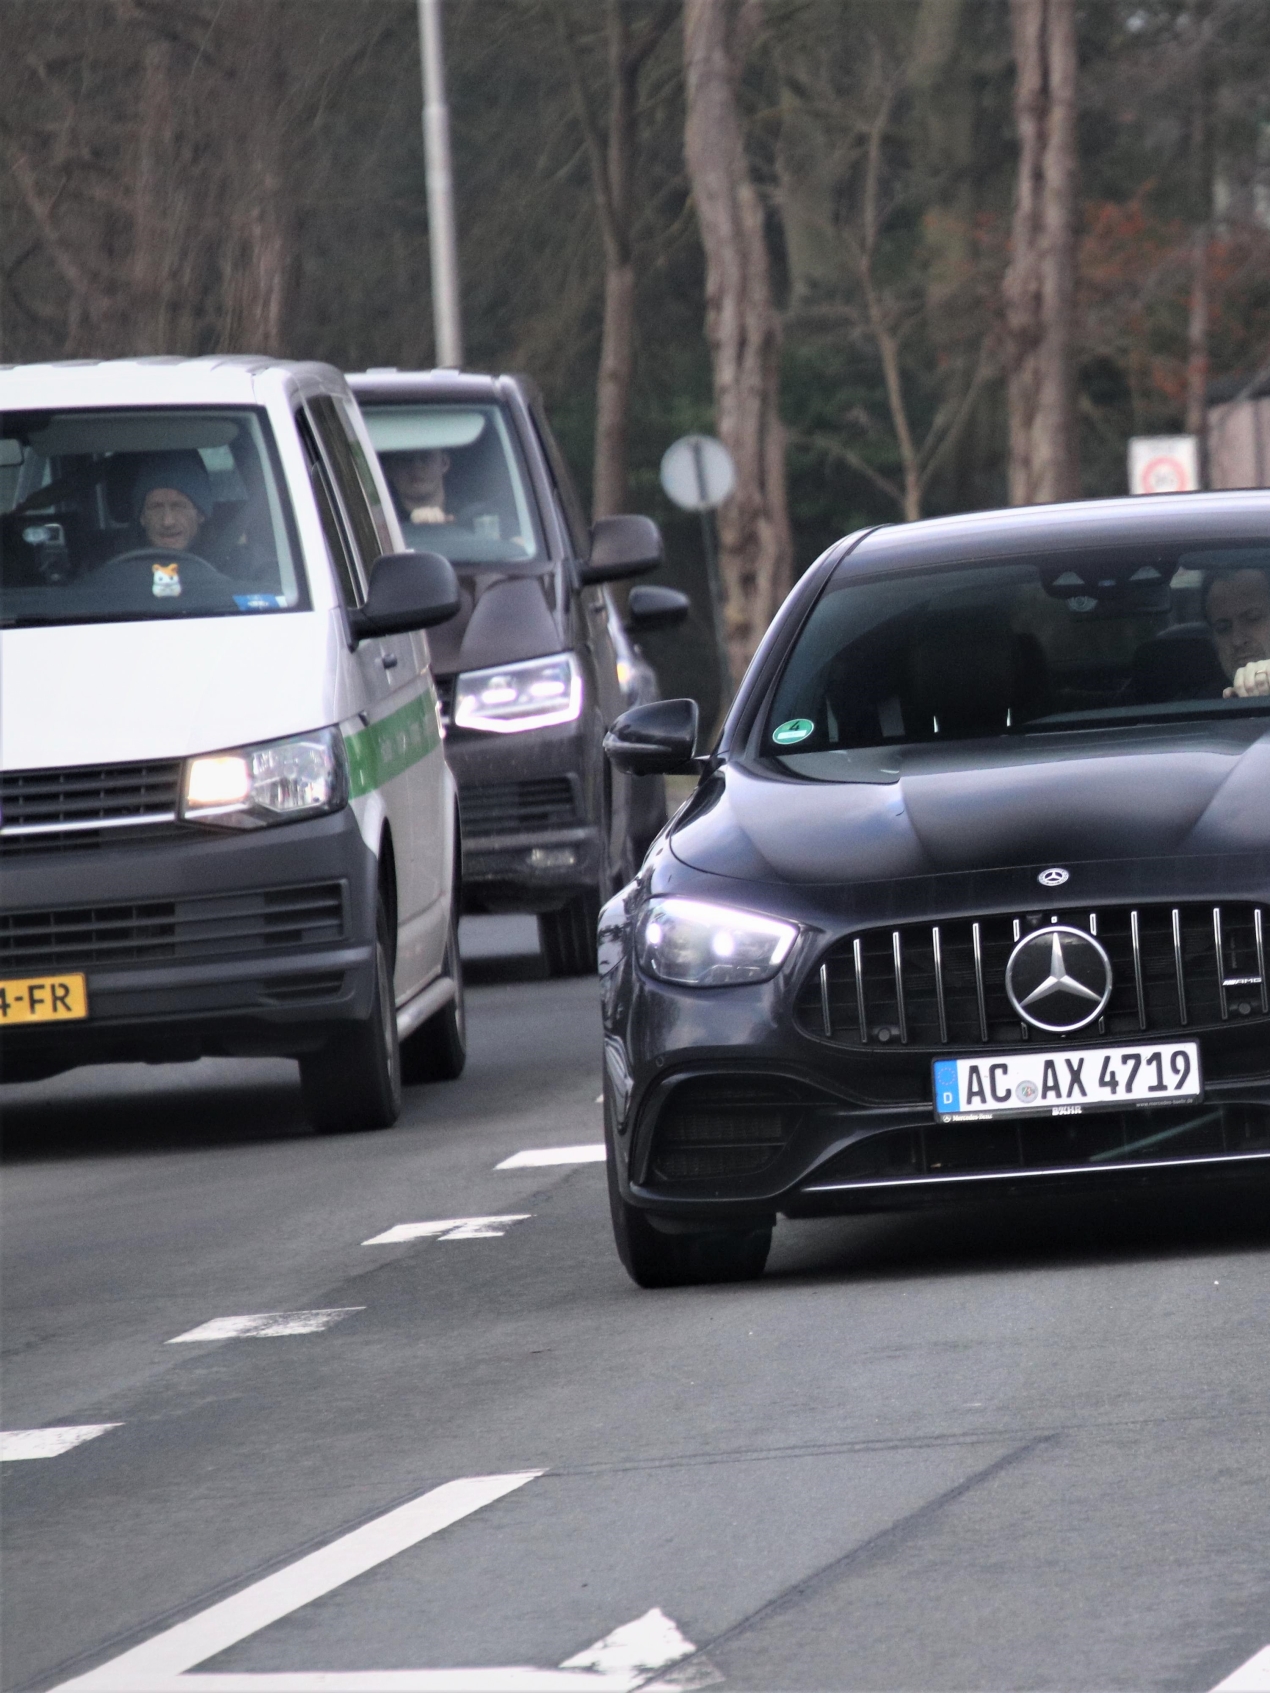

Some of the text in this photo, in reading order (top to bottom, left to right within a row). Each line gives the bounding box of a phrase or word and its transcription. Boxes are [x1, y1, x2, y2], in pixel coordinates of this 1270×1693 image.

[789, 720, 801, 731] 4
[1228, 977, 1262, 986] AMG
[966, 1050, 1191, 1106] AC AX 4719
[943, 1092, 953, 1105] D
